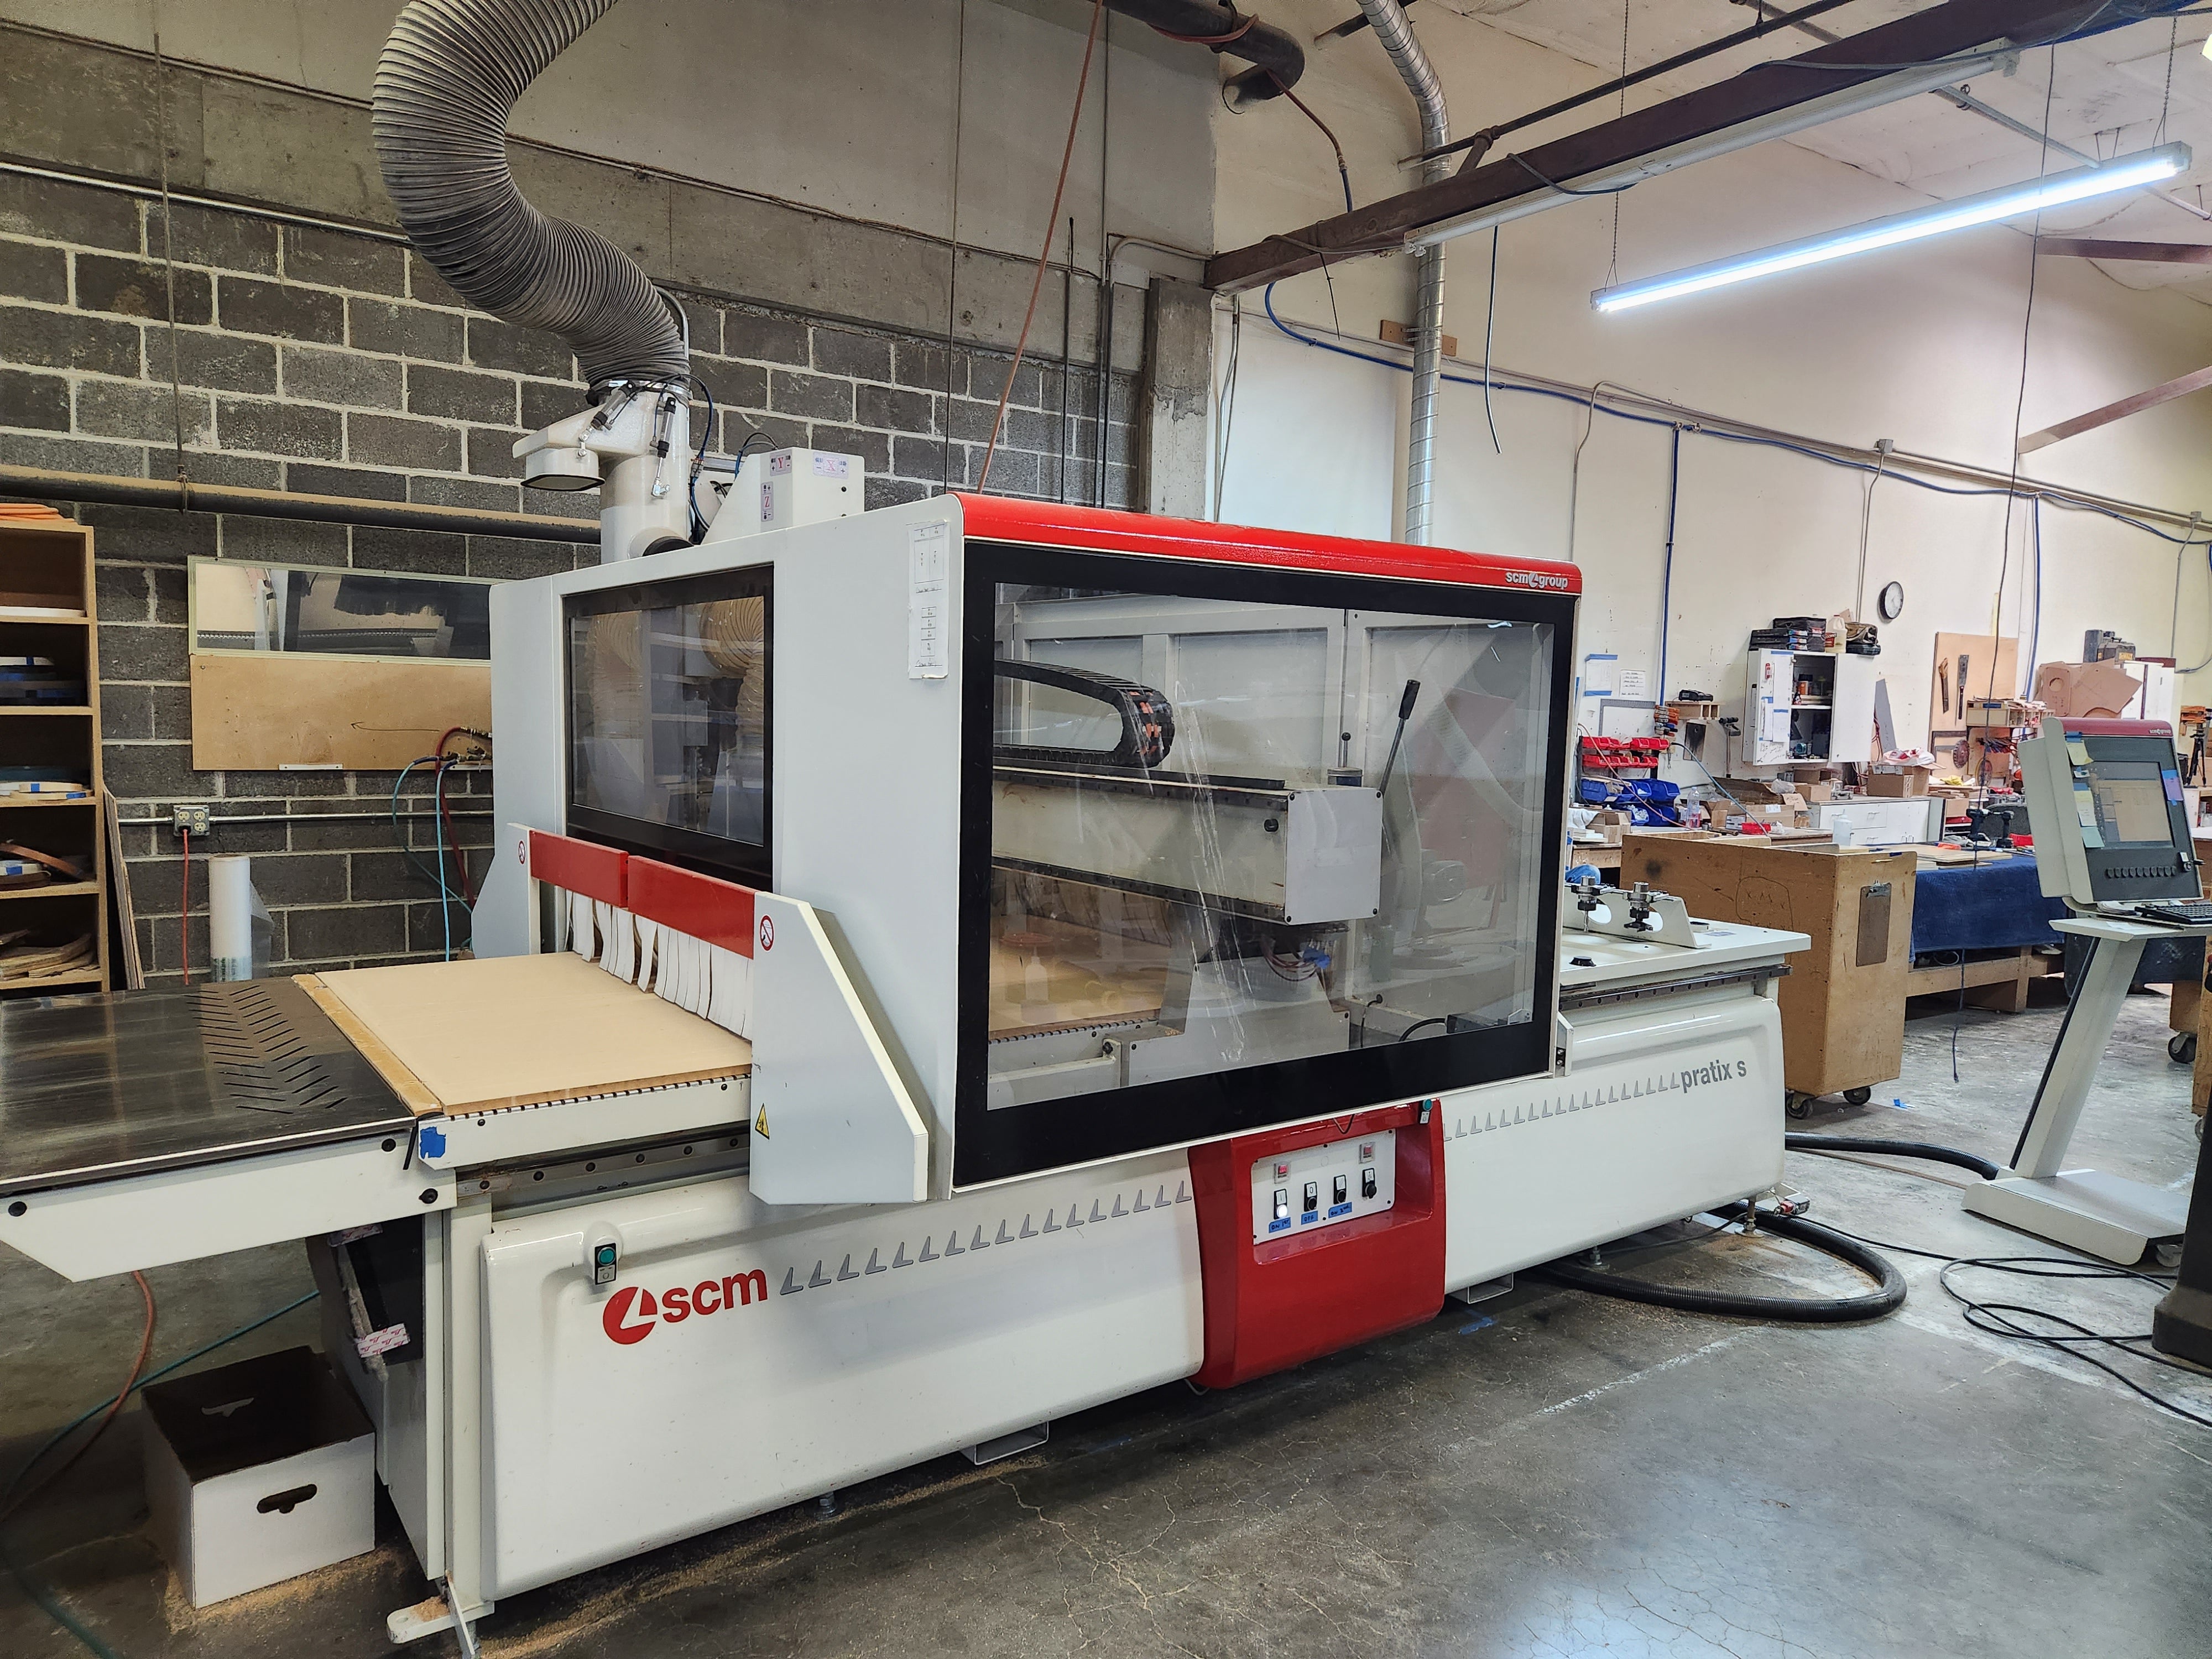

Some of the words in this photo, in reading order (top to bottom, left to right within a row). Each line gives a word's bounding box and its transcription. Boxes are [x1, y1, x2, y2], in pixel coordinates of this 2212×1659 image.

[778, 457, 784, 469] Y
[826, 459, 836, 472] X
[764, 496, 770, 508] Z
[1681, 1059, 1733, 1094] pratix
[1736, 1060, 1747, 1077] s
[661, 1269, 768, 1323] scm
